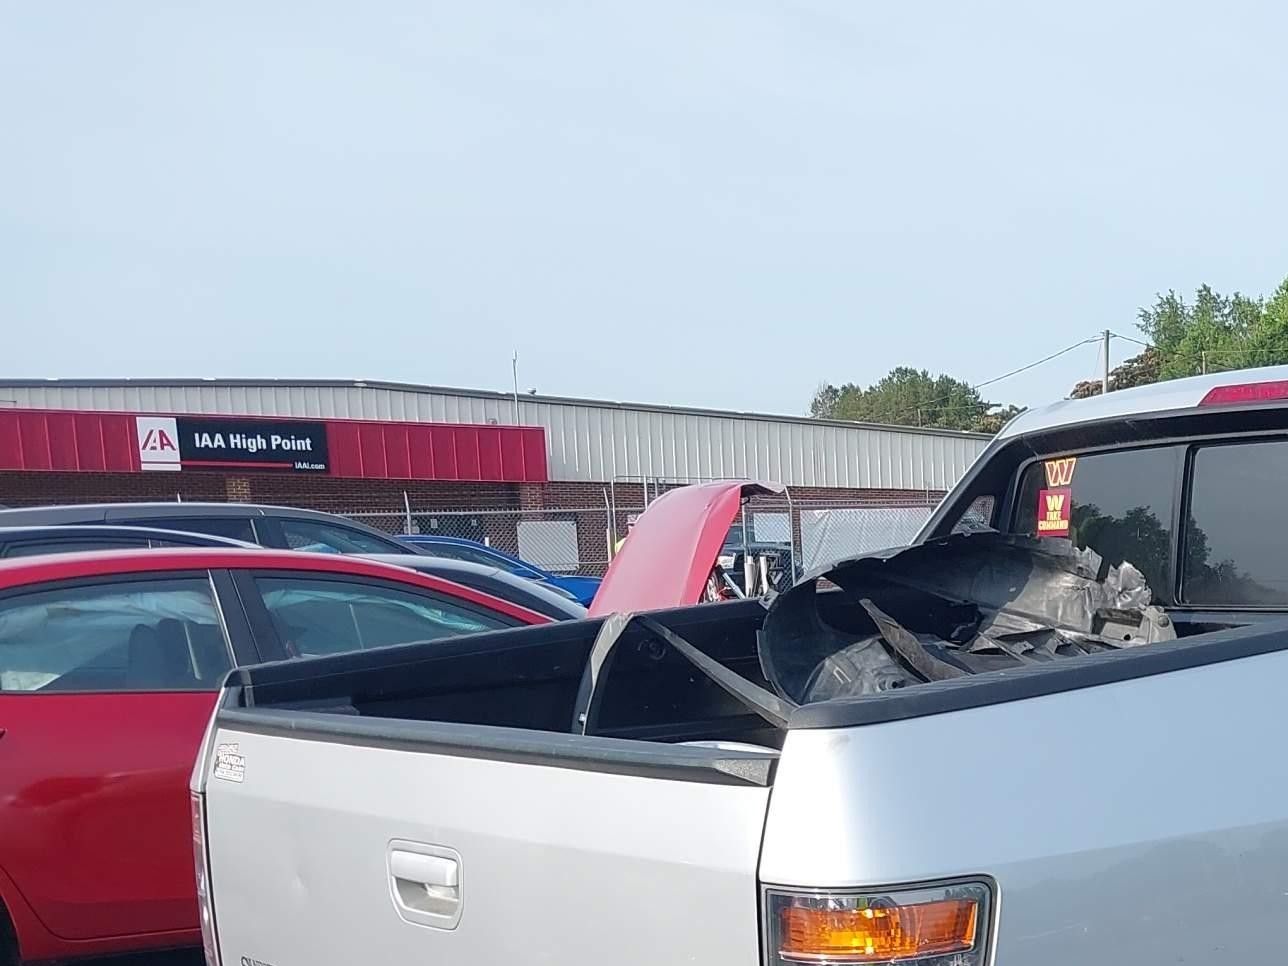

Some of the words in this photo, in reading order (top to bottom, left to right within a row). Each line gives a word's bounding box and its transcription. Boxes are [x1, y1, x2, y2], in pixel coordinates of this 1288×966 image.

[194, 433, 226, 449] IAA
[229, 434, 267, 453] High
[271, 435, 313, 451] Point
[1045, 457, 1077, 487] W
[1045, 494, 1065, 511] W
[1046, 511, 1062, 521] TAKE
[1038, 520, 1069, 530] COMMAND
[218, 754, 245, 766] HONDA
